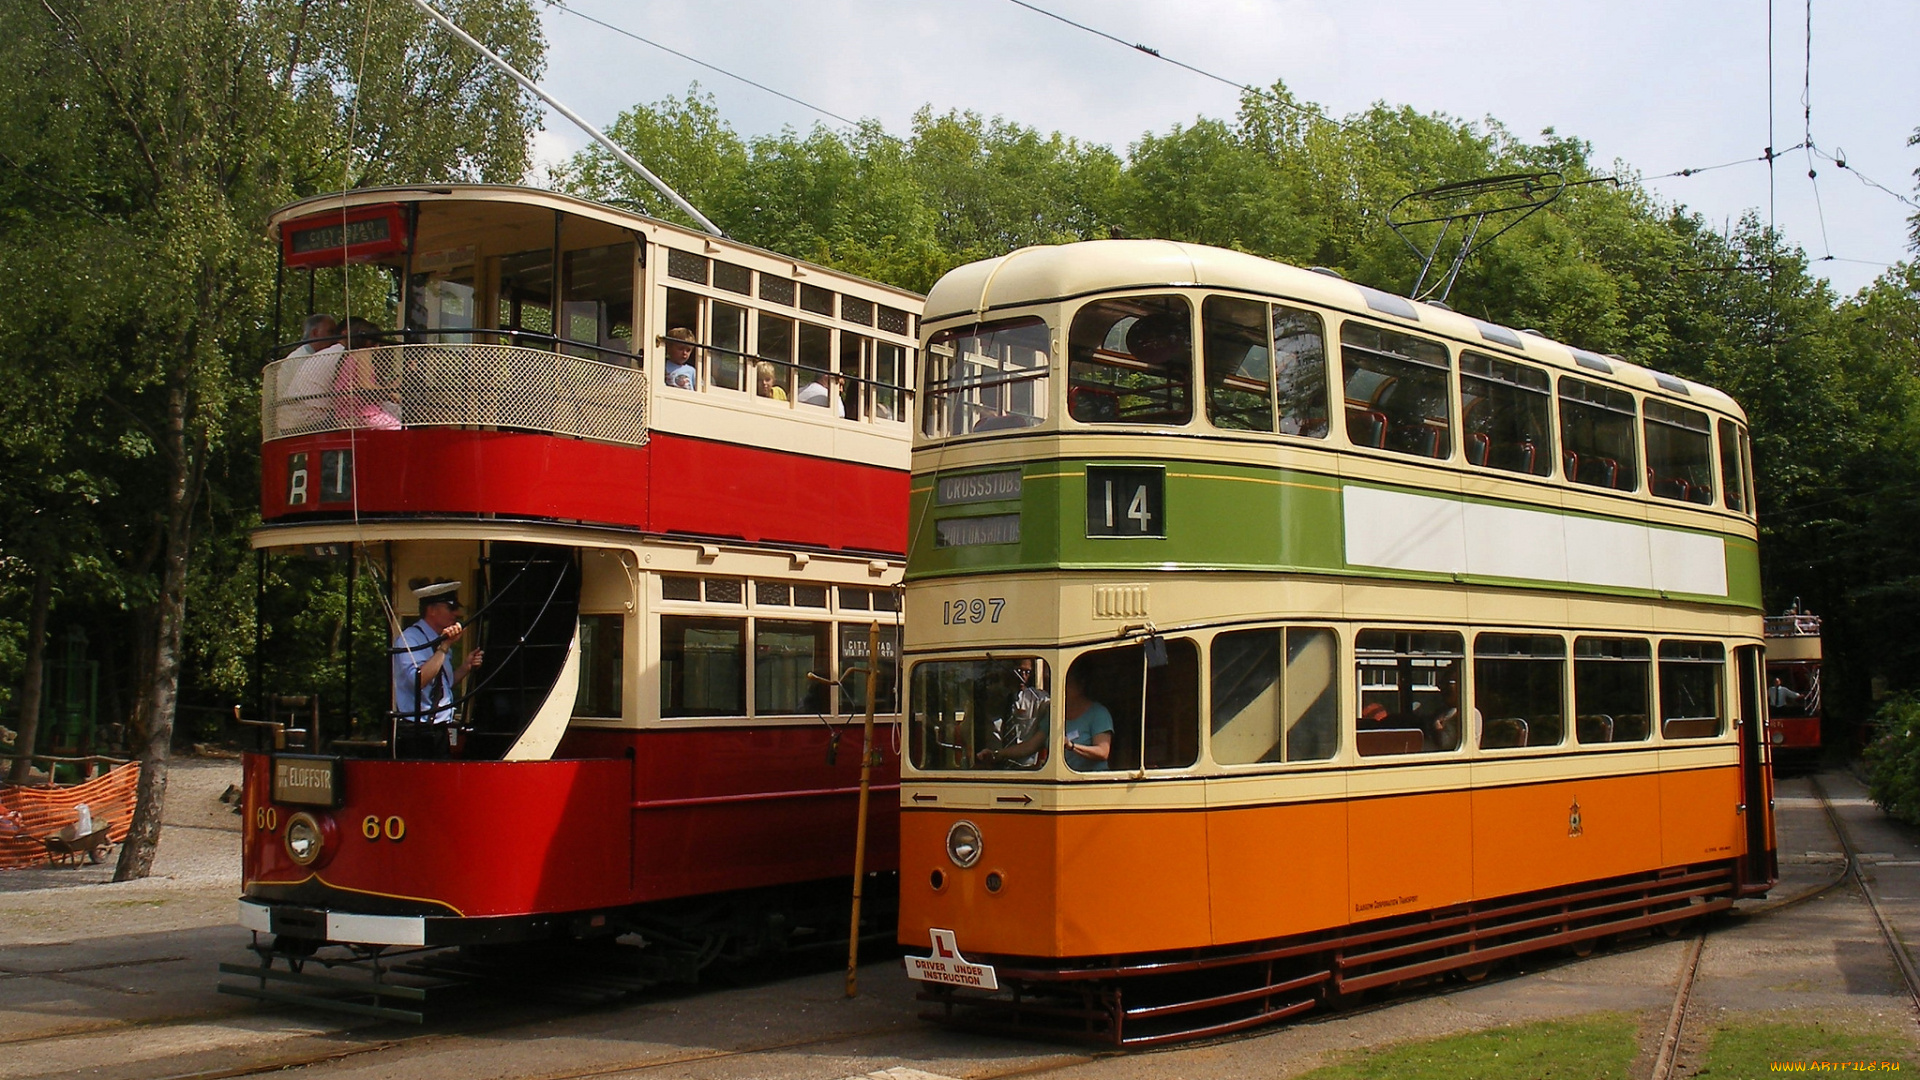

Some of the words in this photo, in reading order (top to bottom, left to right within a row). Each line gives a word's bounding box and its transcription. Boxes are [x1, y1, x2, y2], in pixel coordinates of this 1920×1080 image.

[1105, 480, 1152, 532] 14
[943, 597, 1006, 626] 1297
[848, 641, 867, 650] CITY
[256, 806, 278, 831] 60
[362, 815, 406, 841] 60
[936, 935, 953, 958] L
[915, 959, 946, 972] DRIVER
[953, 964, 983, 976] UNDER
[924, 970, 981, 985] INSTRUCTION
